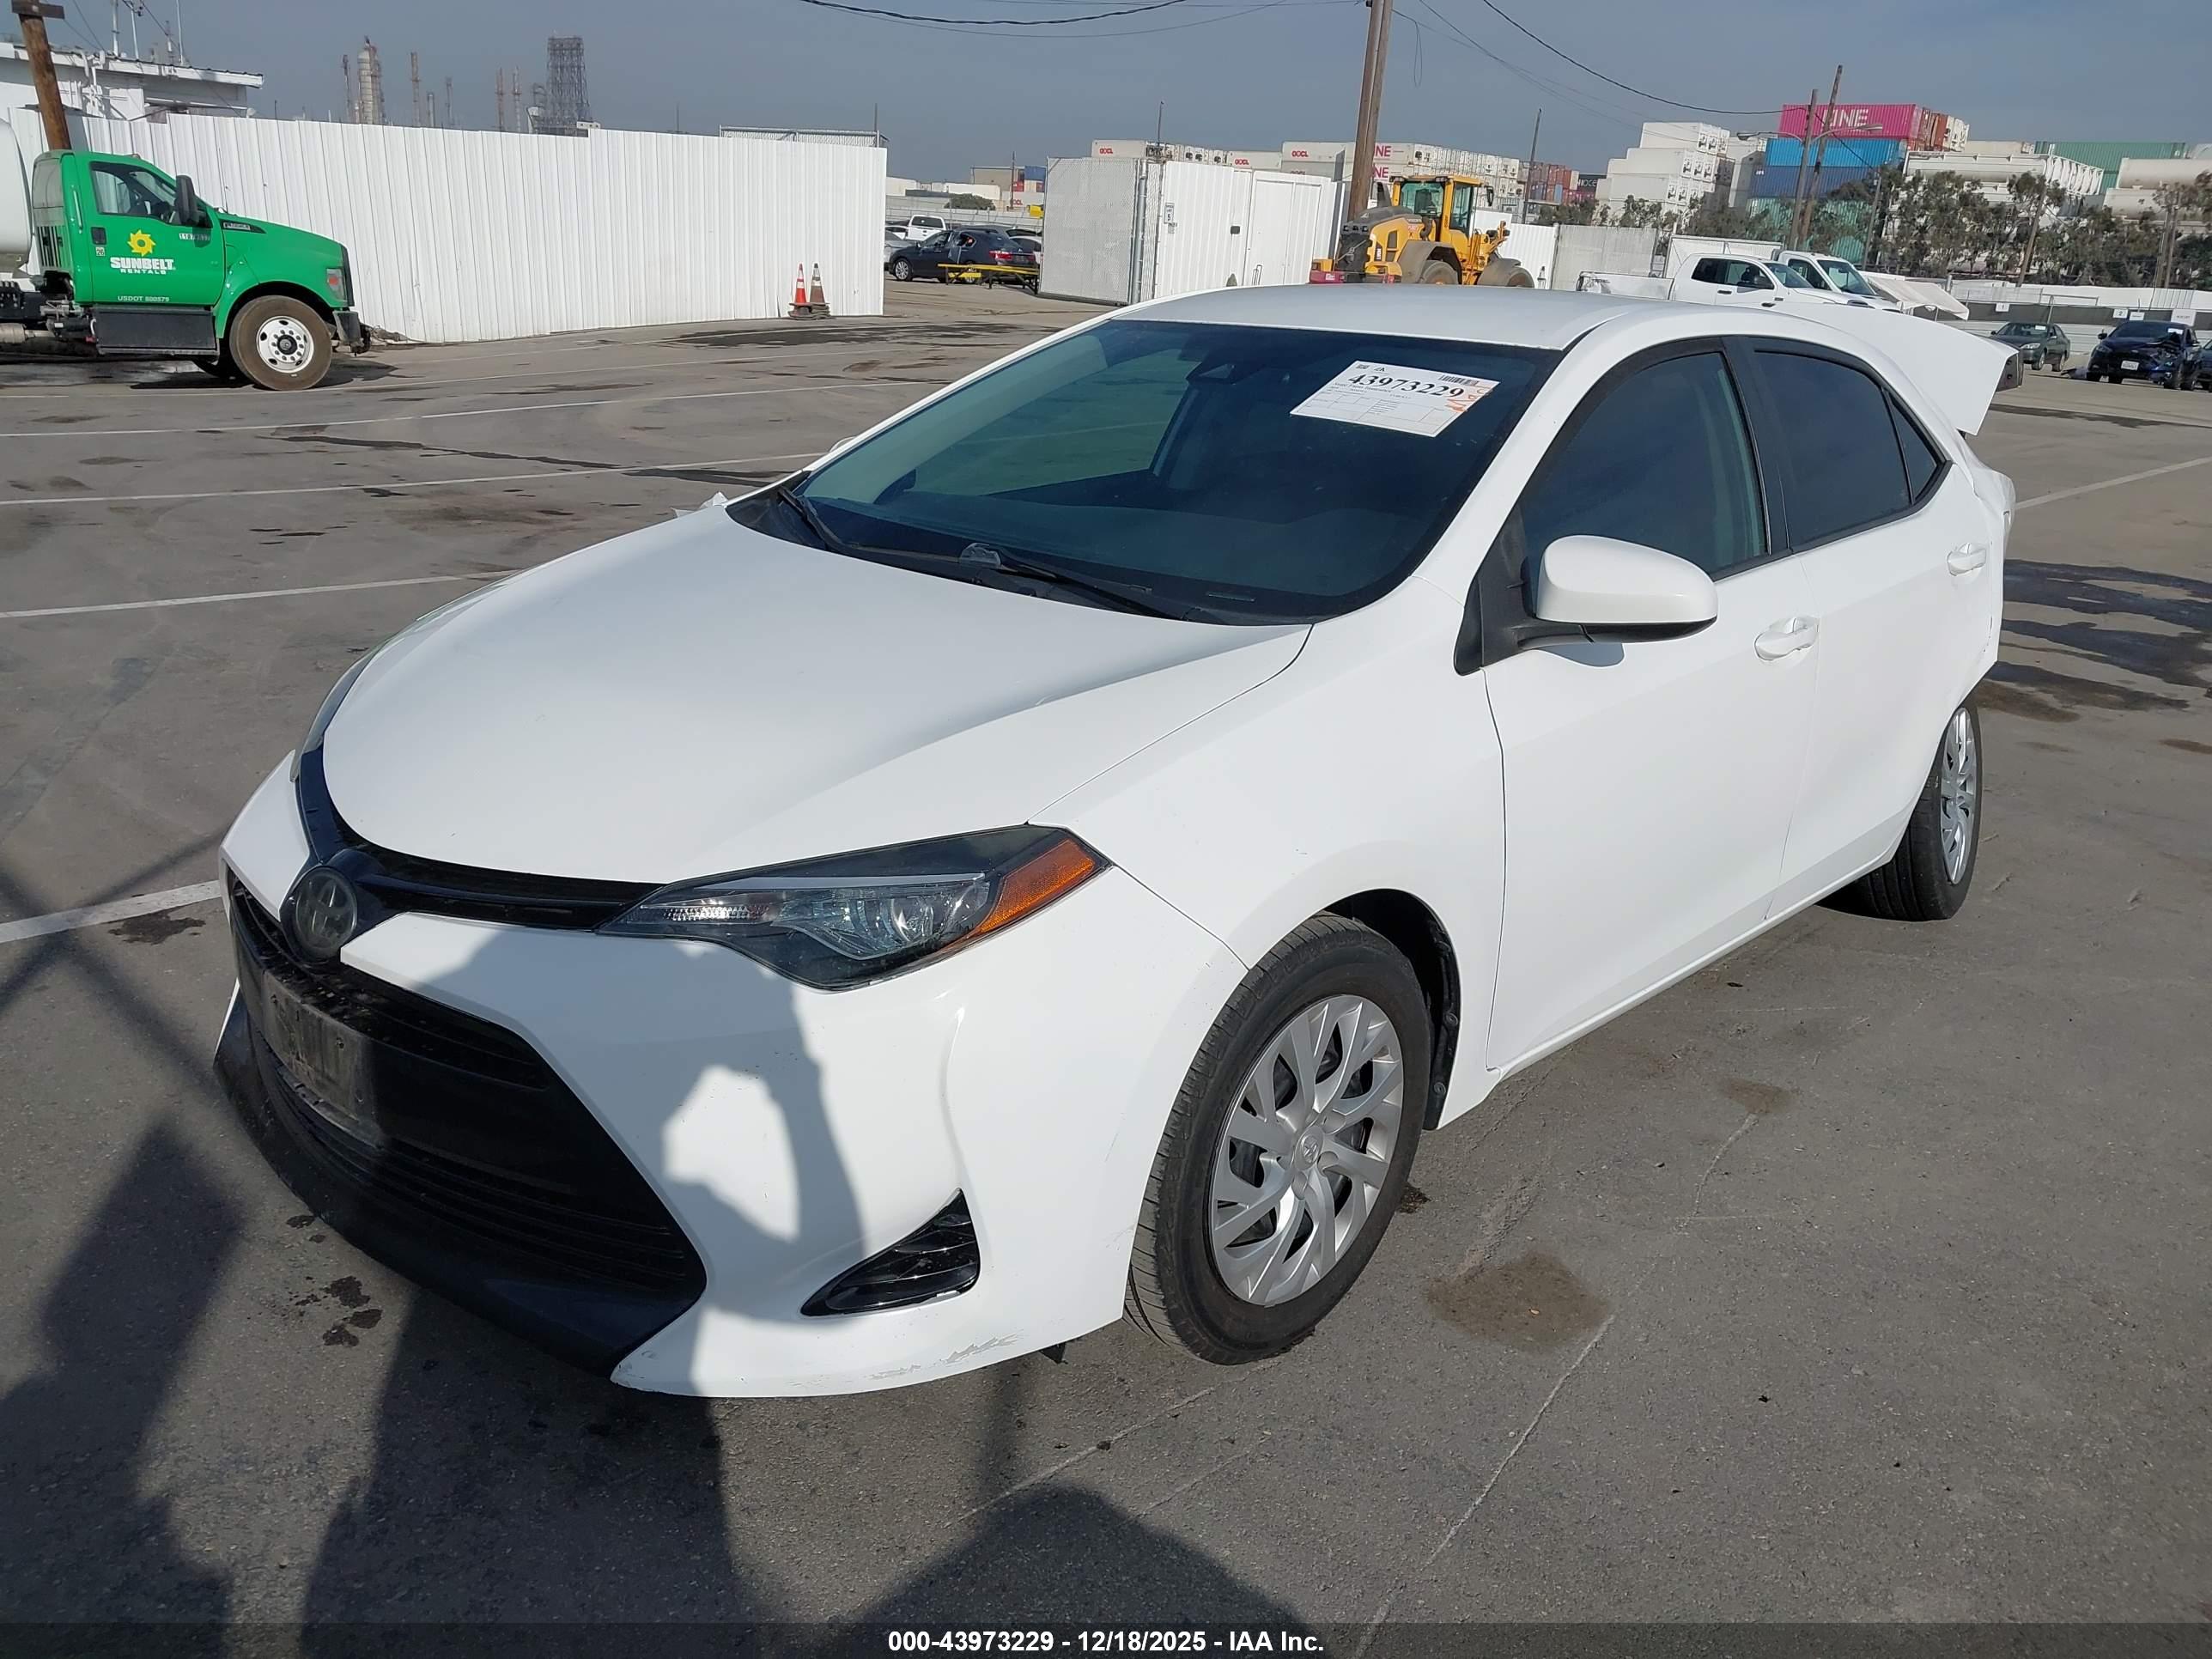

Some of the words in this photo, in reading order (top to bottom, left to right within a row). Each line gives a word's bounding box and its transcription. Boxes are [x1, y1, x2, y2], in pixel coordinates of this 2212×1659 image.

[1291, 149, 1310, 158] OOCL
[110, 257, 174, 270] SUNBELT
[1348, 373, 1465, 398] 43973229
